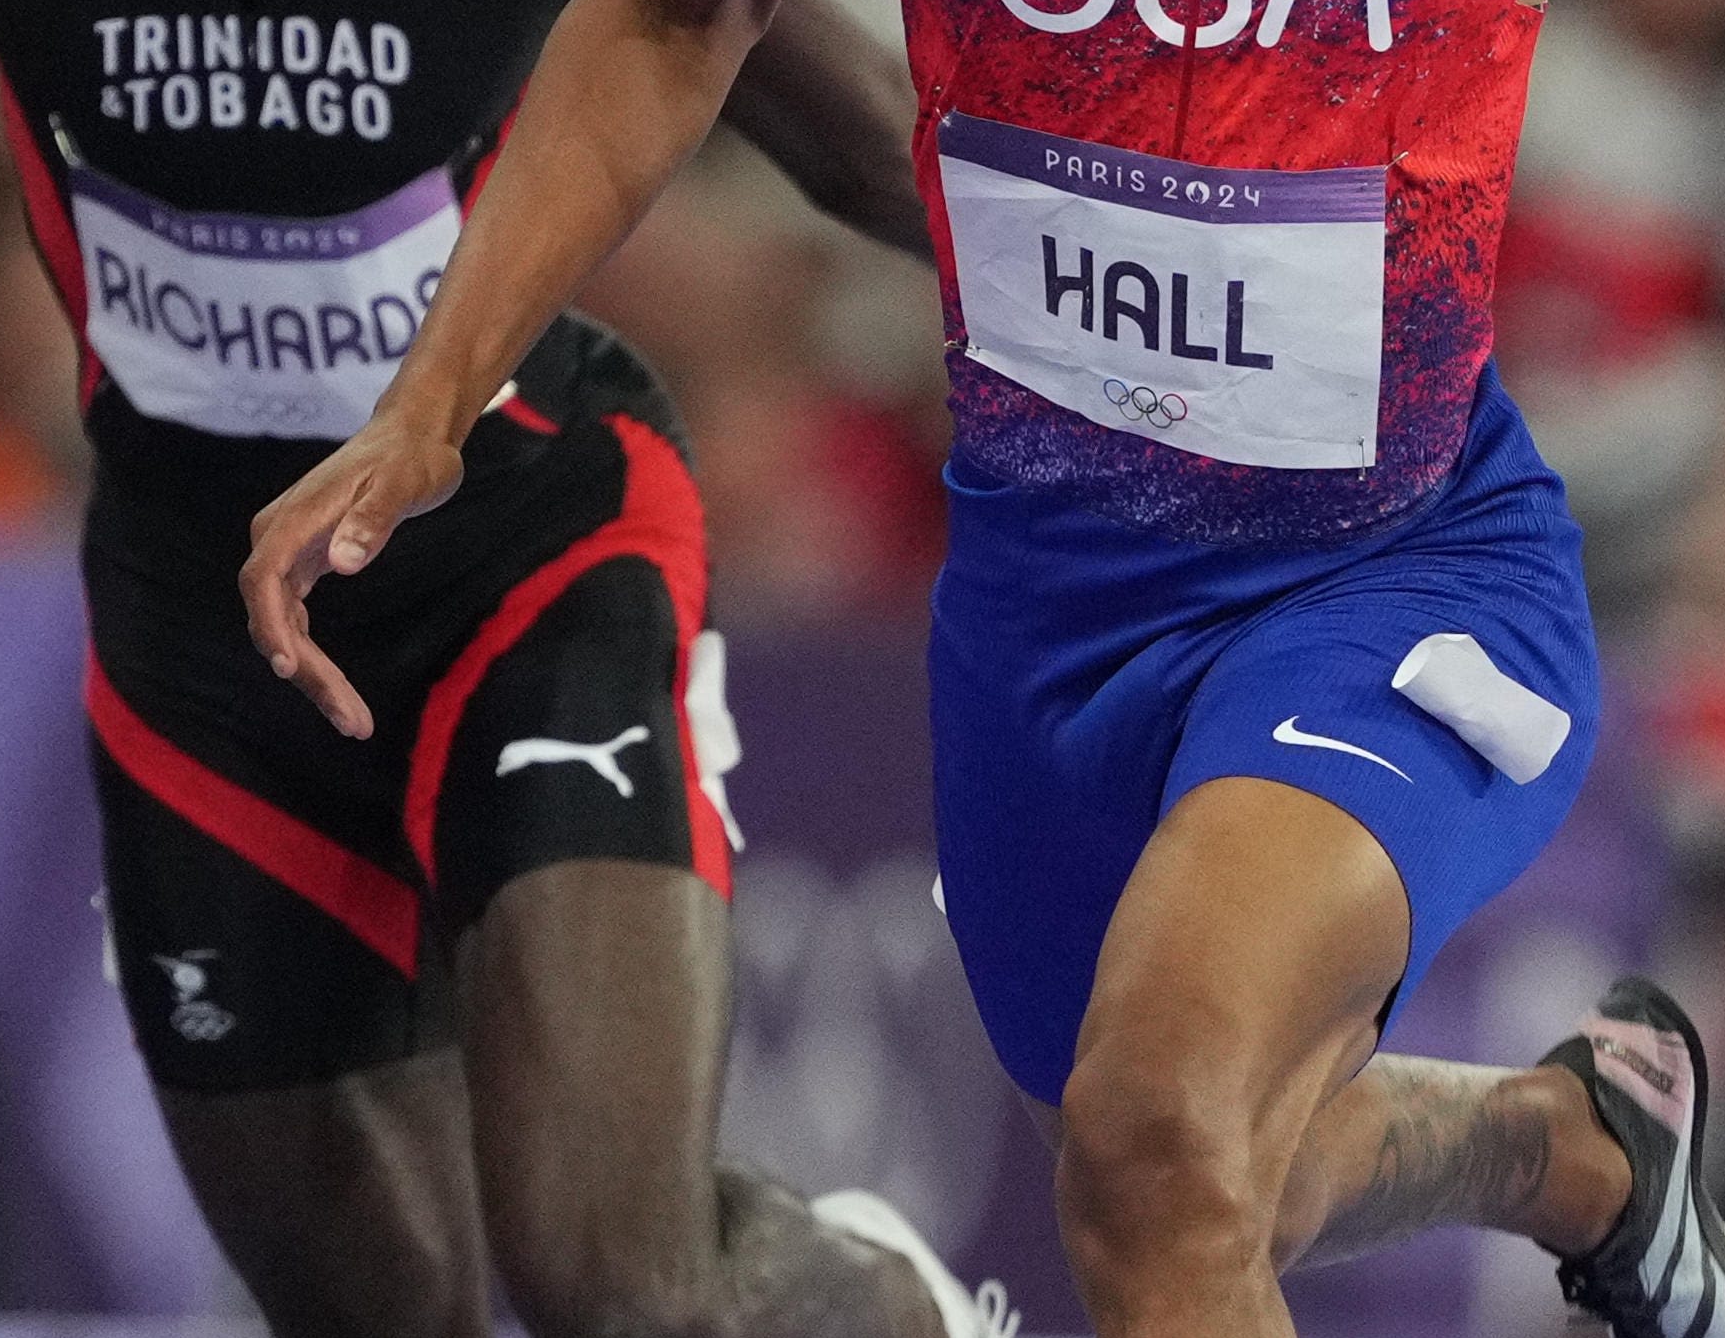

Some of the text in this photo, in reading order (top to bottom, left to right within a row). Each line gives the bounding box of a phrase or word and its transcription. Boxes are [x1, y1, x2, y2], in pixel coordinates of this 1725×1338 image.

[93, 13, 412, 85] TRINIDAD
[1161, 176, 1260, 208] 2024
[1041, 234, 1274, 371] HALL
